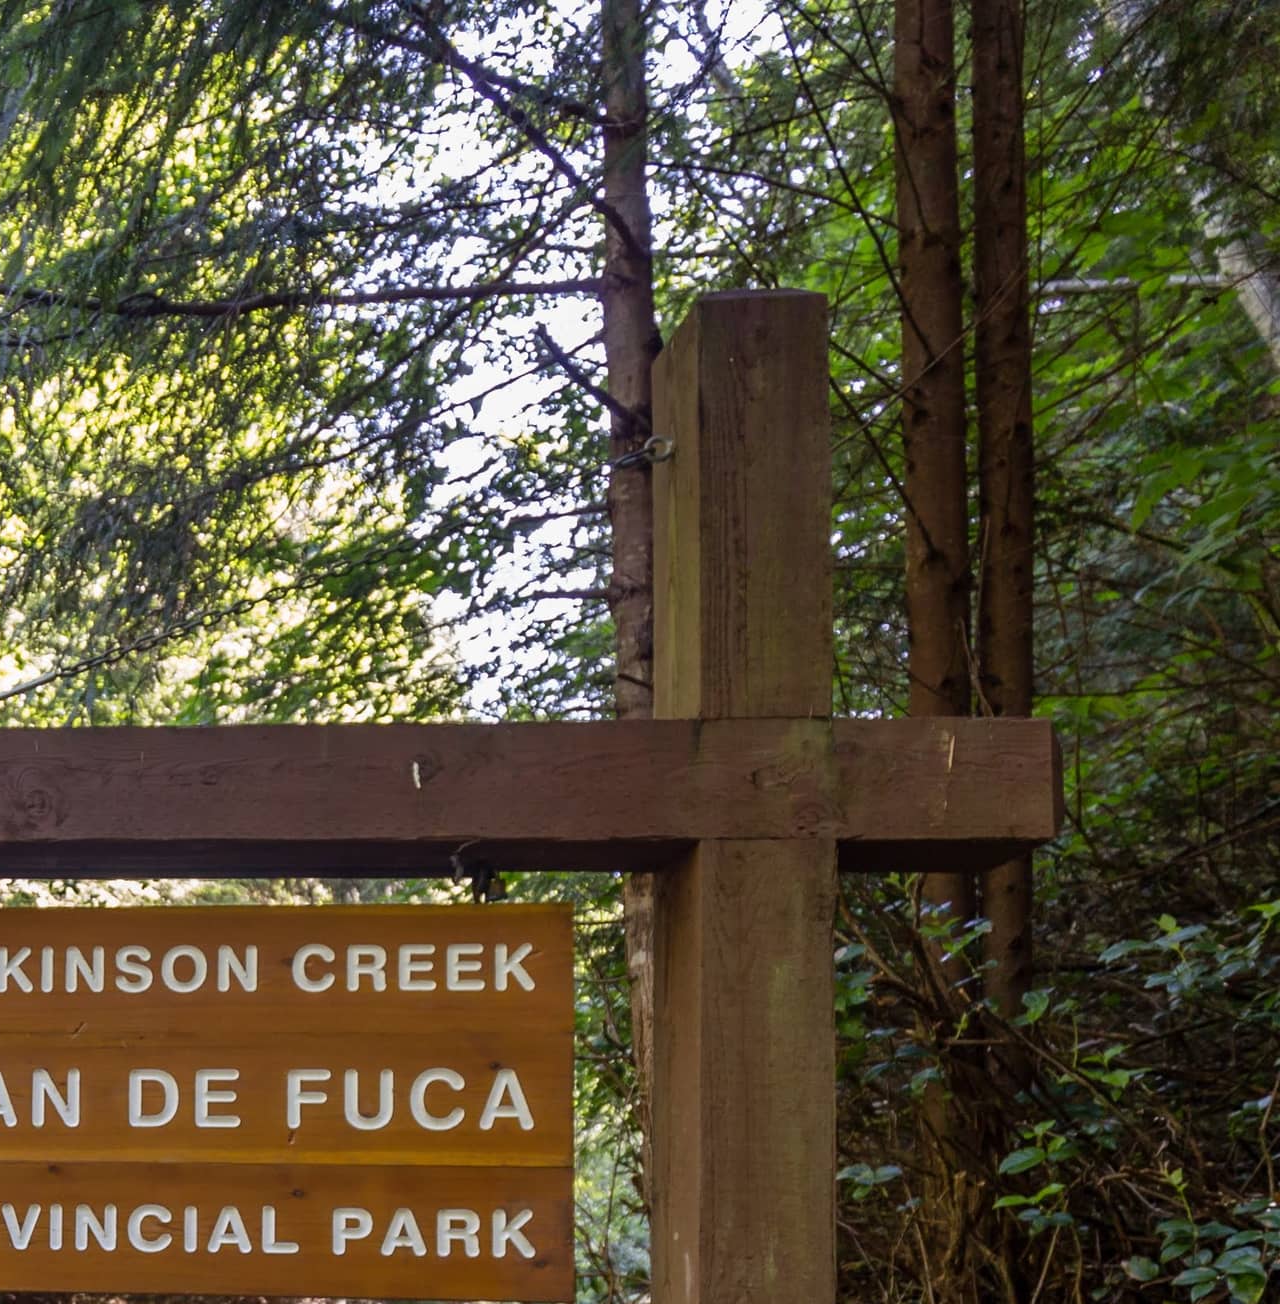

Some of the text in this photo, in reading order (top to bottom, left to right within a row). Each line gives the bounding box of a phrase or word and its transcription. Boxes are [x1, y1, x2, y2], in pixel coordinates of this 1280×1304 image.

[291, 942, 537, 993] CREEK
[127, 1068, 242, 1129] DE
[286, 1067, 536, 1132] FUCA
[331, 1207, 538, 1260] PARK
